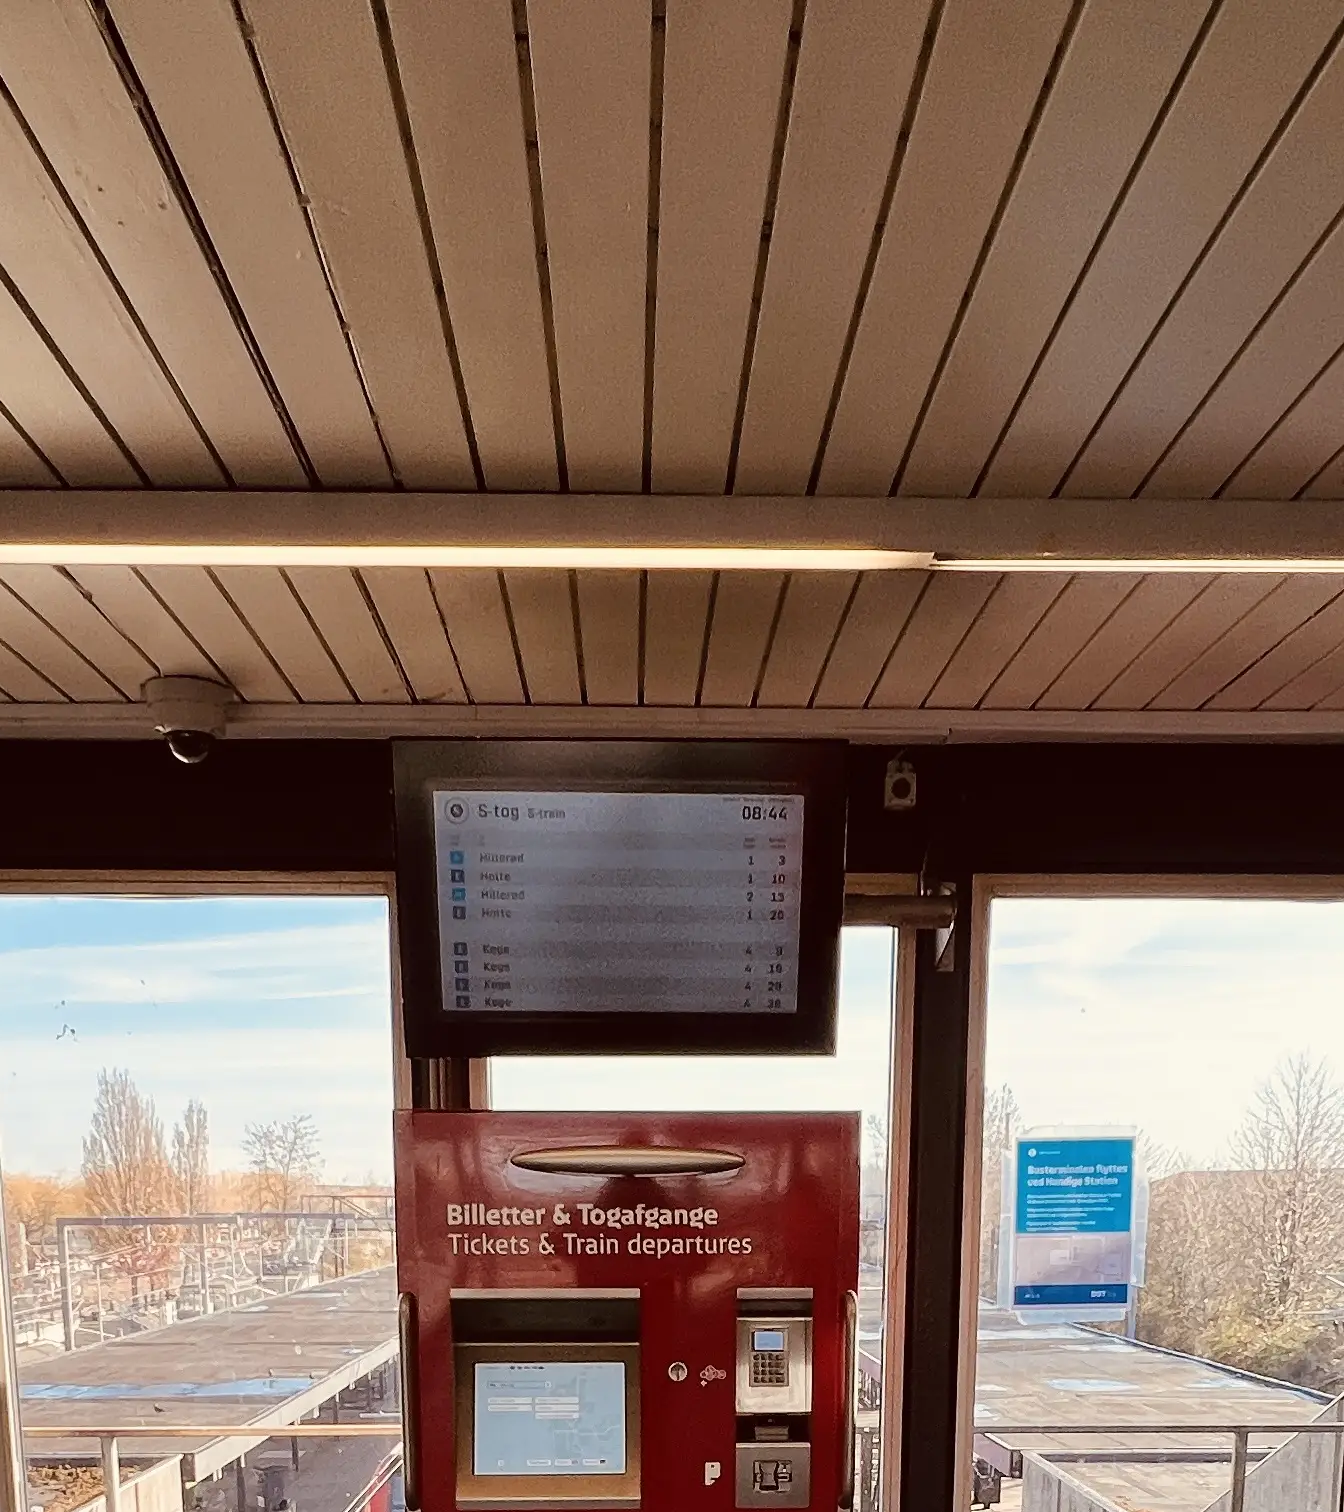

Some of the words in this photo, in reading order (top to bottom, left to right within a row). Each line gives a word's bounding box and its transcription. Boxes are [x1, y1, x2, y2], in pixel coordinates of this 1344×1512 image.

[478, 803, 520, 821] S-tog
[527, 807, 566, 819] S-train
[742, 806, 788, 821] 08:44
[748, 856, 754, 866] 1
[778, 855, 786, 866] 3
[771, 873, 786, 884] 10
[746, 892, 754, 902] 2
[446, 1202, 546, 1227] Billetter
[552, 1204, 571, 1226] &
[575, 1202, 720, 1230] Togafgange
[447, 1232, 530, 1256] Tickets
[538, 1233, 556, 1256] &
[562, 1232, 619, 1256] Train
[627, 1231, 752, 1259] departures
